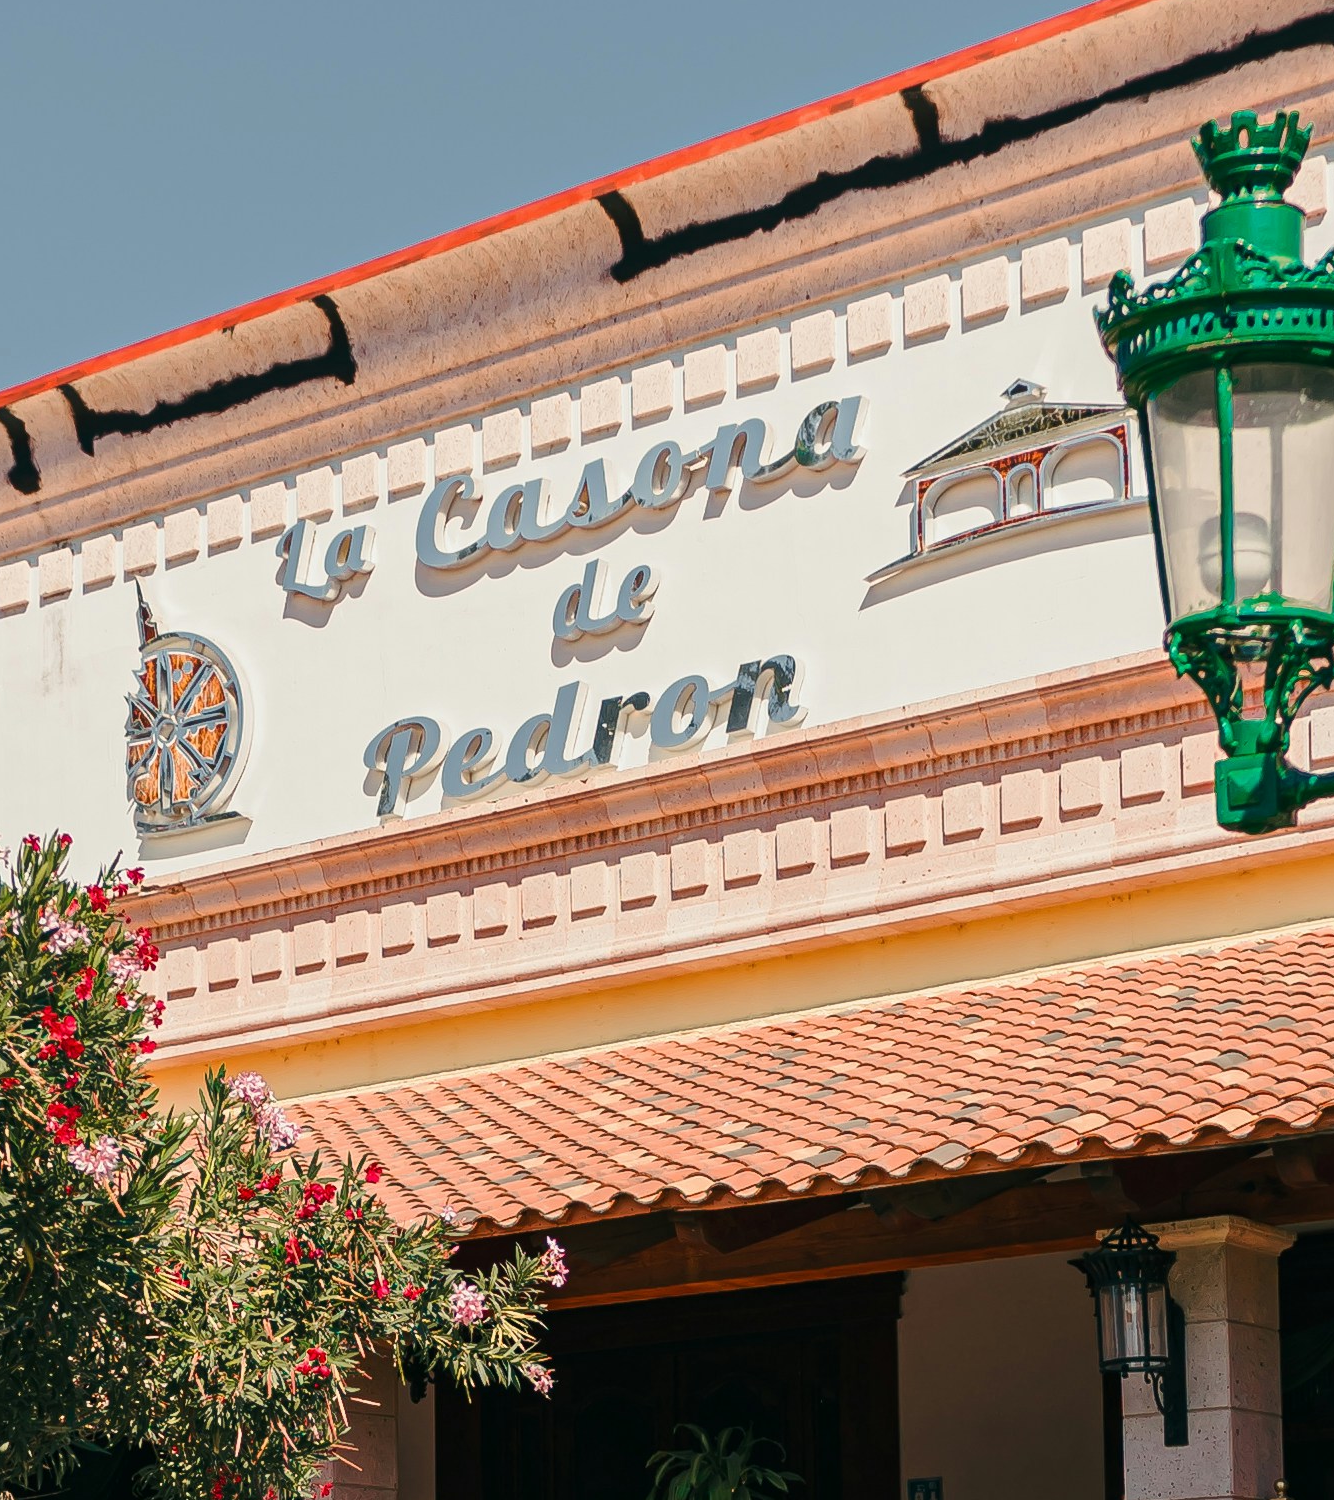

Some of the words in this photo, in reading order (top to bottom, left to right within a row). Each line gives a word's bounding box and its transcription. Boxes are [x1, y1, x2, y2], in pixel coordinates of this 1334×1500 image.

[278, 517, 374, 601] La
[416, 395, 868, 568] Casona
[553, 560, 659, 641] de
[364, 653, 807, 817] Pedron
